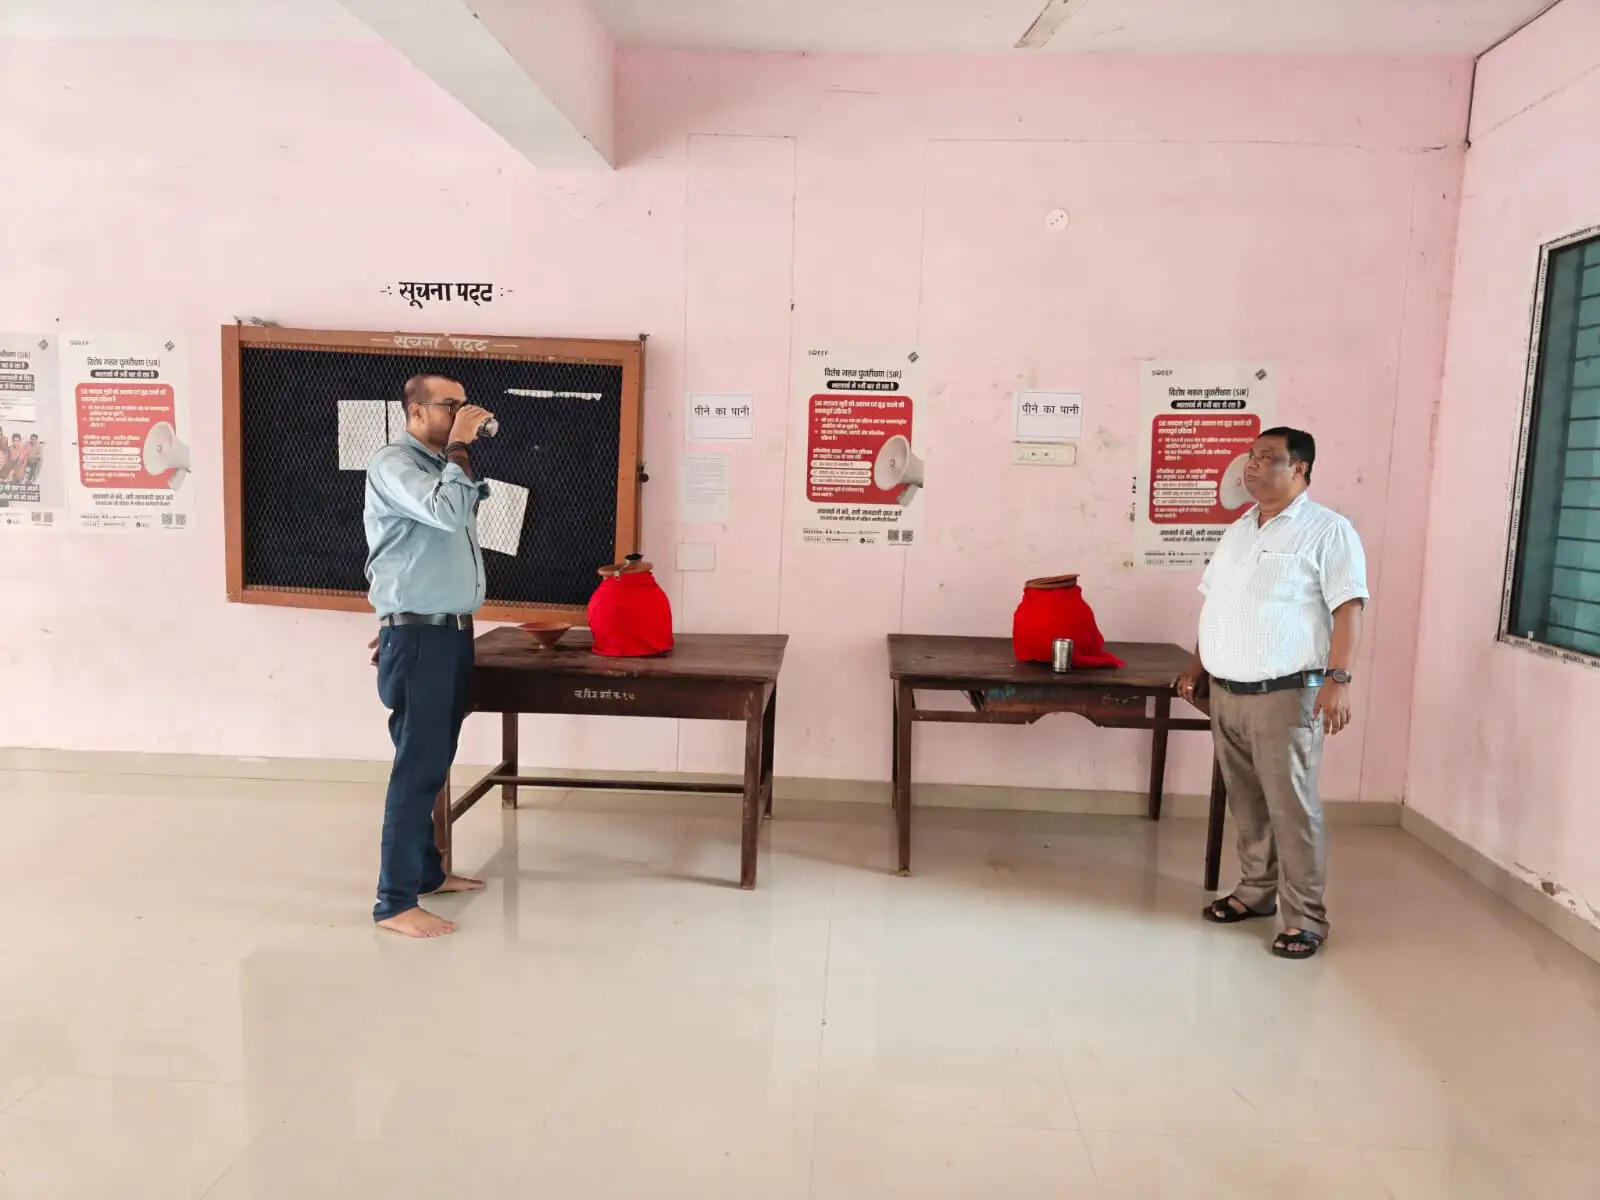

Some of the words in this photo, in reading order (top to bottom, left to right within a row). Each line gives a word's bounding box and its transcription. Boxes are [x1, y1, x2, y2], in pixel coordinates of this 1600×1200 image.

[399, 281, 453, 309] सूचना
[394, 336, 443, 349] सूचना
[886, 370, 902, 379] (SIR)
[1233, 388, 1249, 397] (SIR)
[694, 405, 710, 416] पीने
[715, 407, 727, 416] का
[731, 406, 750, 416] पानी
[1022, 402, 1038, 414] पीने
[1043, 405, 1055, 414] का
[1060, 404, 1080, 414] पानी
